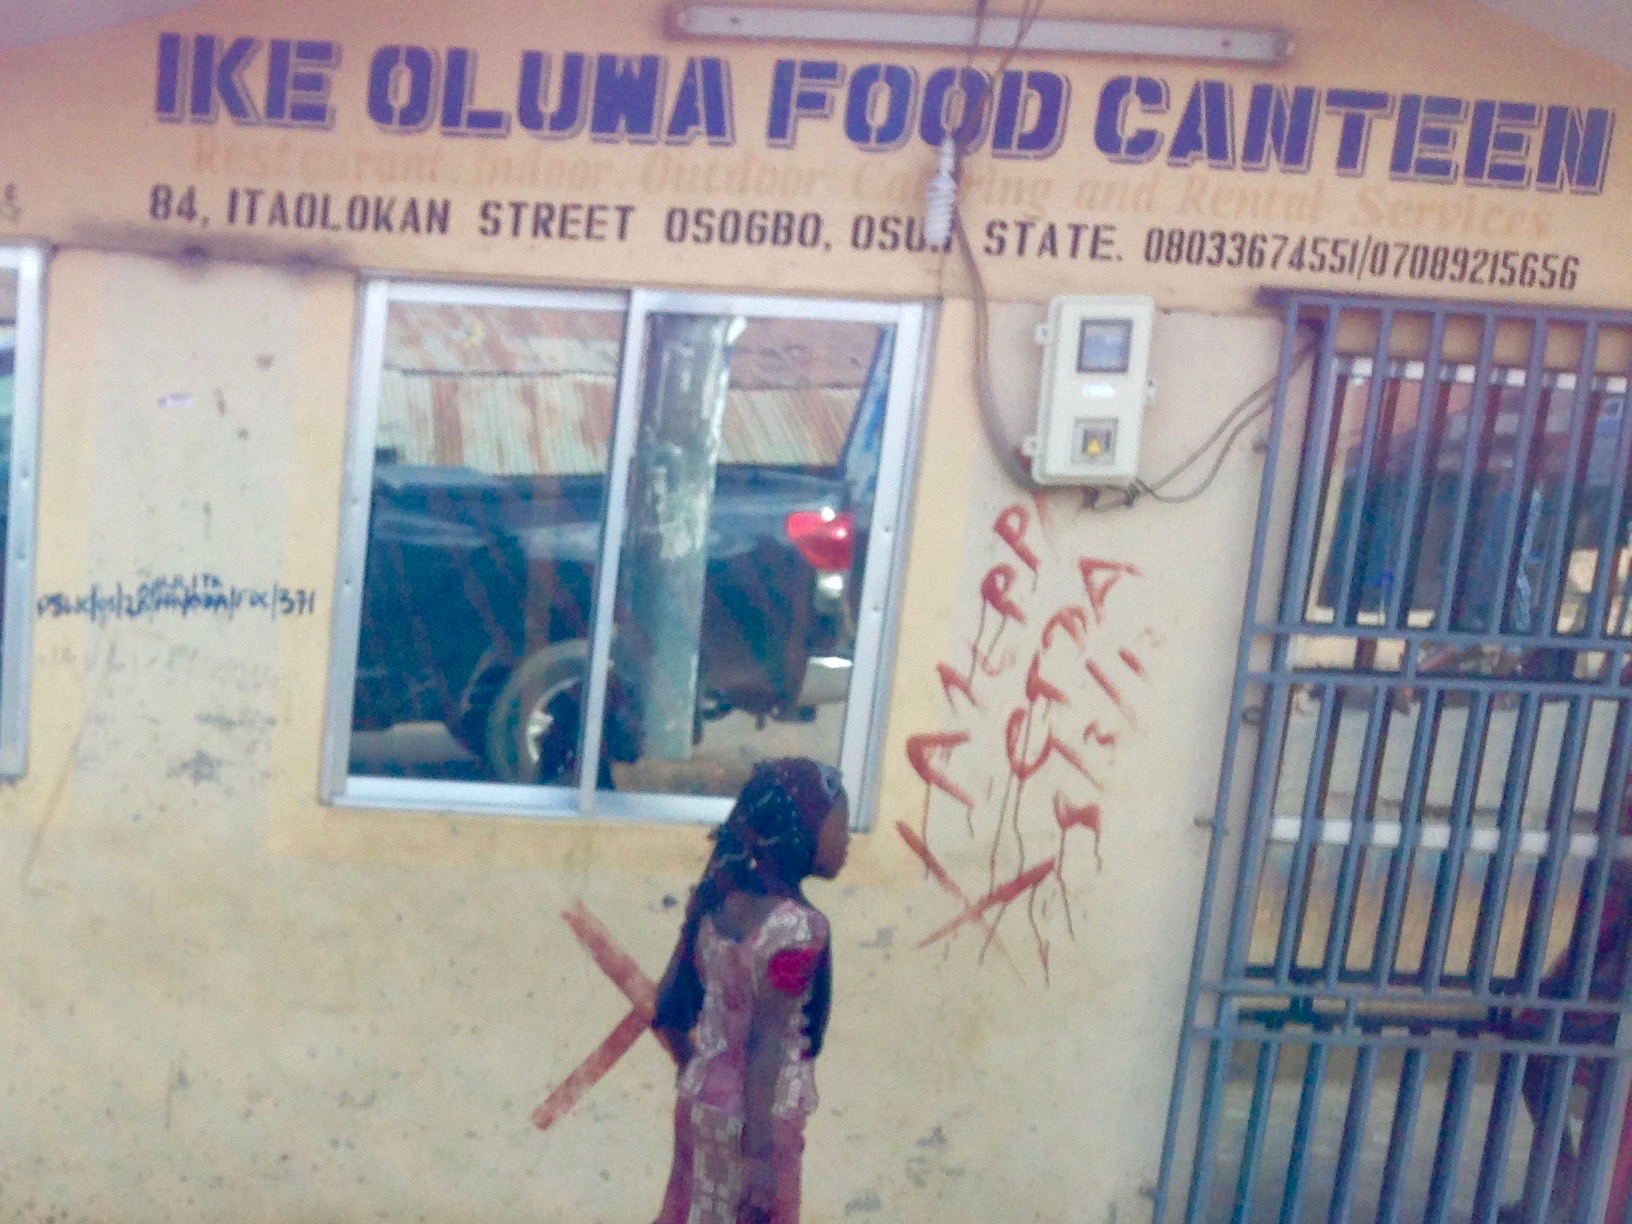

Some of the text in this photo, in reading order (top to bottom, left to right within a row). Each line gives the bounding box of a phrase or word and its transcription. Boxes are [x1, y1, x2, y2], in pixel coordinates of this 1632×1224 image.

[155, 32, 1615, 195] IKE OLUWA FOOD CANTEEN
[226, 187, 451, 235] ITAOLOKAN
[479, 200, 637, 242] STREET
[850, 213, 954, 254] OSU
